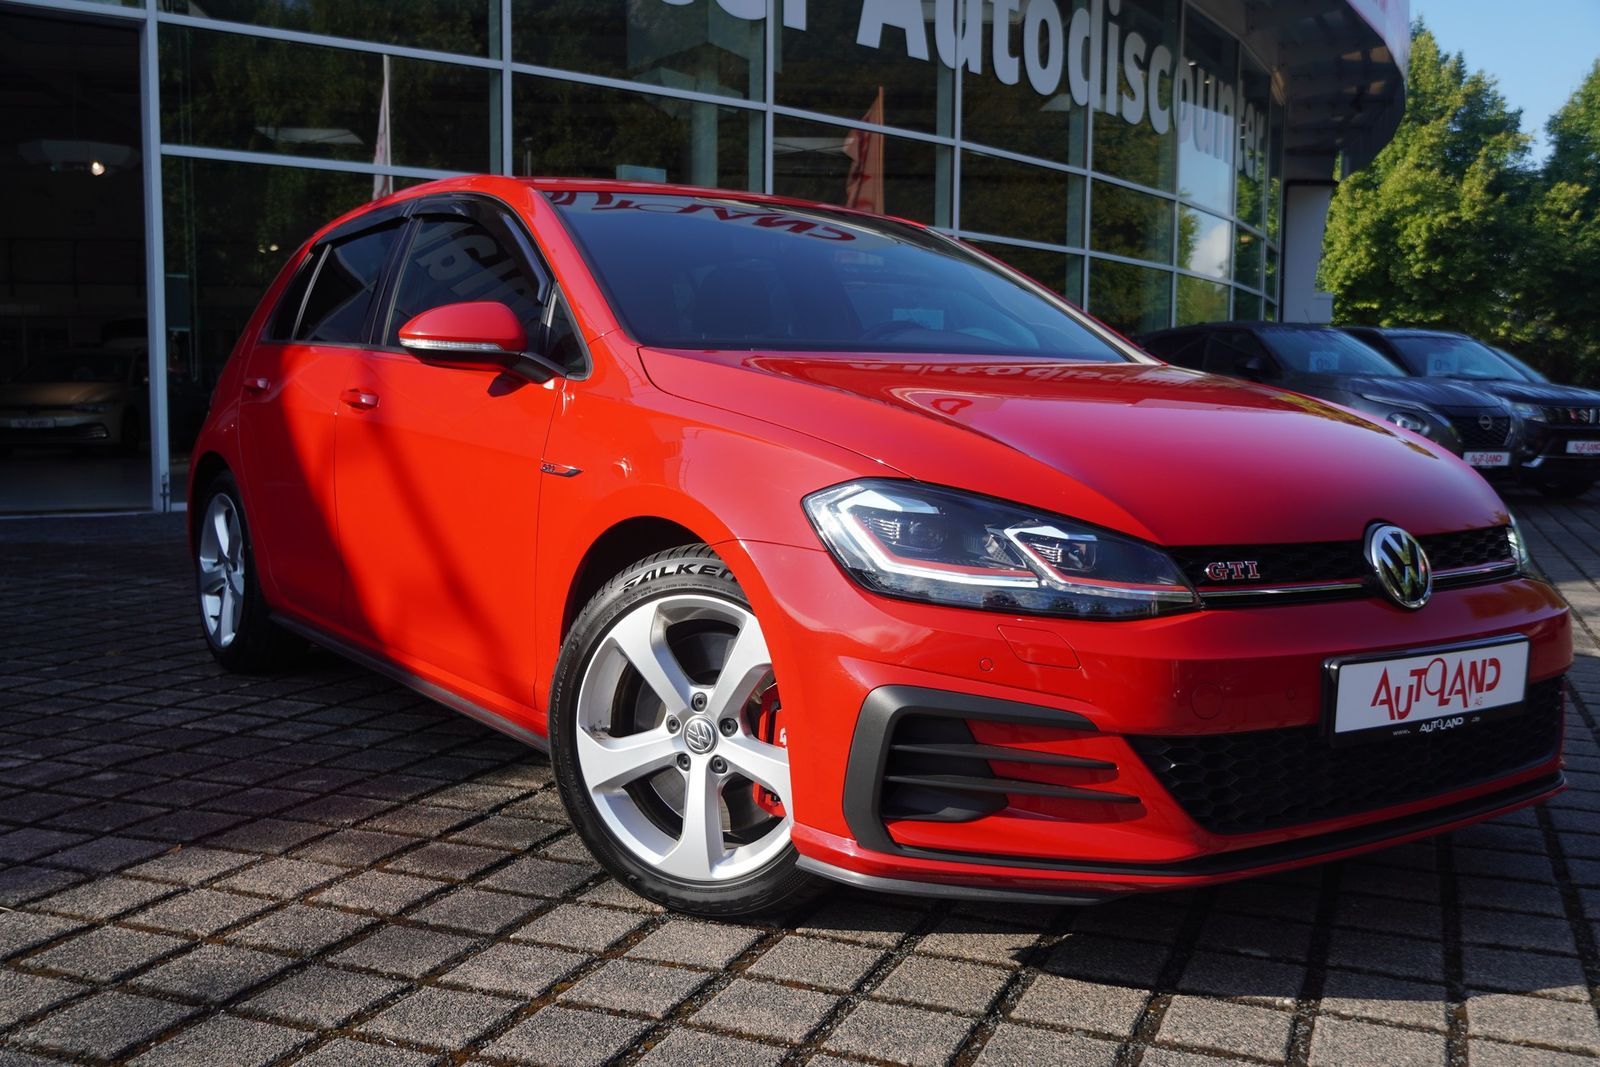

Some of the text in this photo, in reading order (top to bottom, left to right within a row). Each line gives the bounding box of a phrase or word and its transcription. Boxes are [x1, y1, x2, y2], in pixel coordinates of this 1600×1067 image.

[1204, 560, 1261, 581] GTI
[1370, 657, 1502, 721] AUTOLAND
[1419, 716, 1464, 734] AUTOLAND
